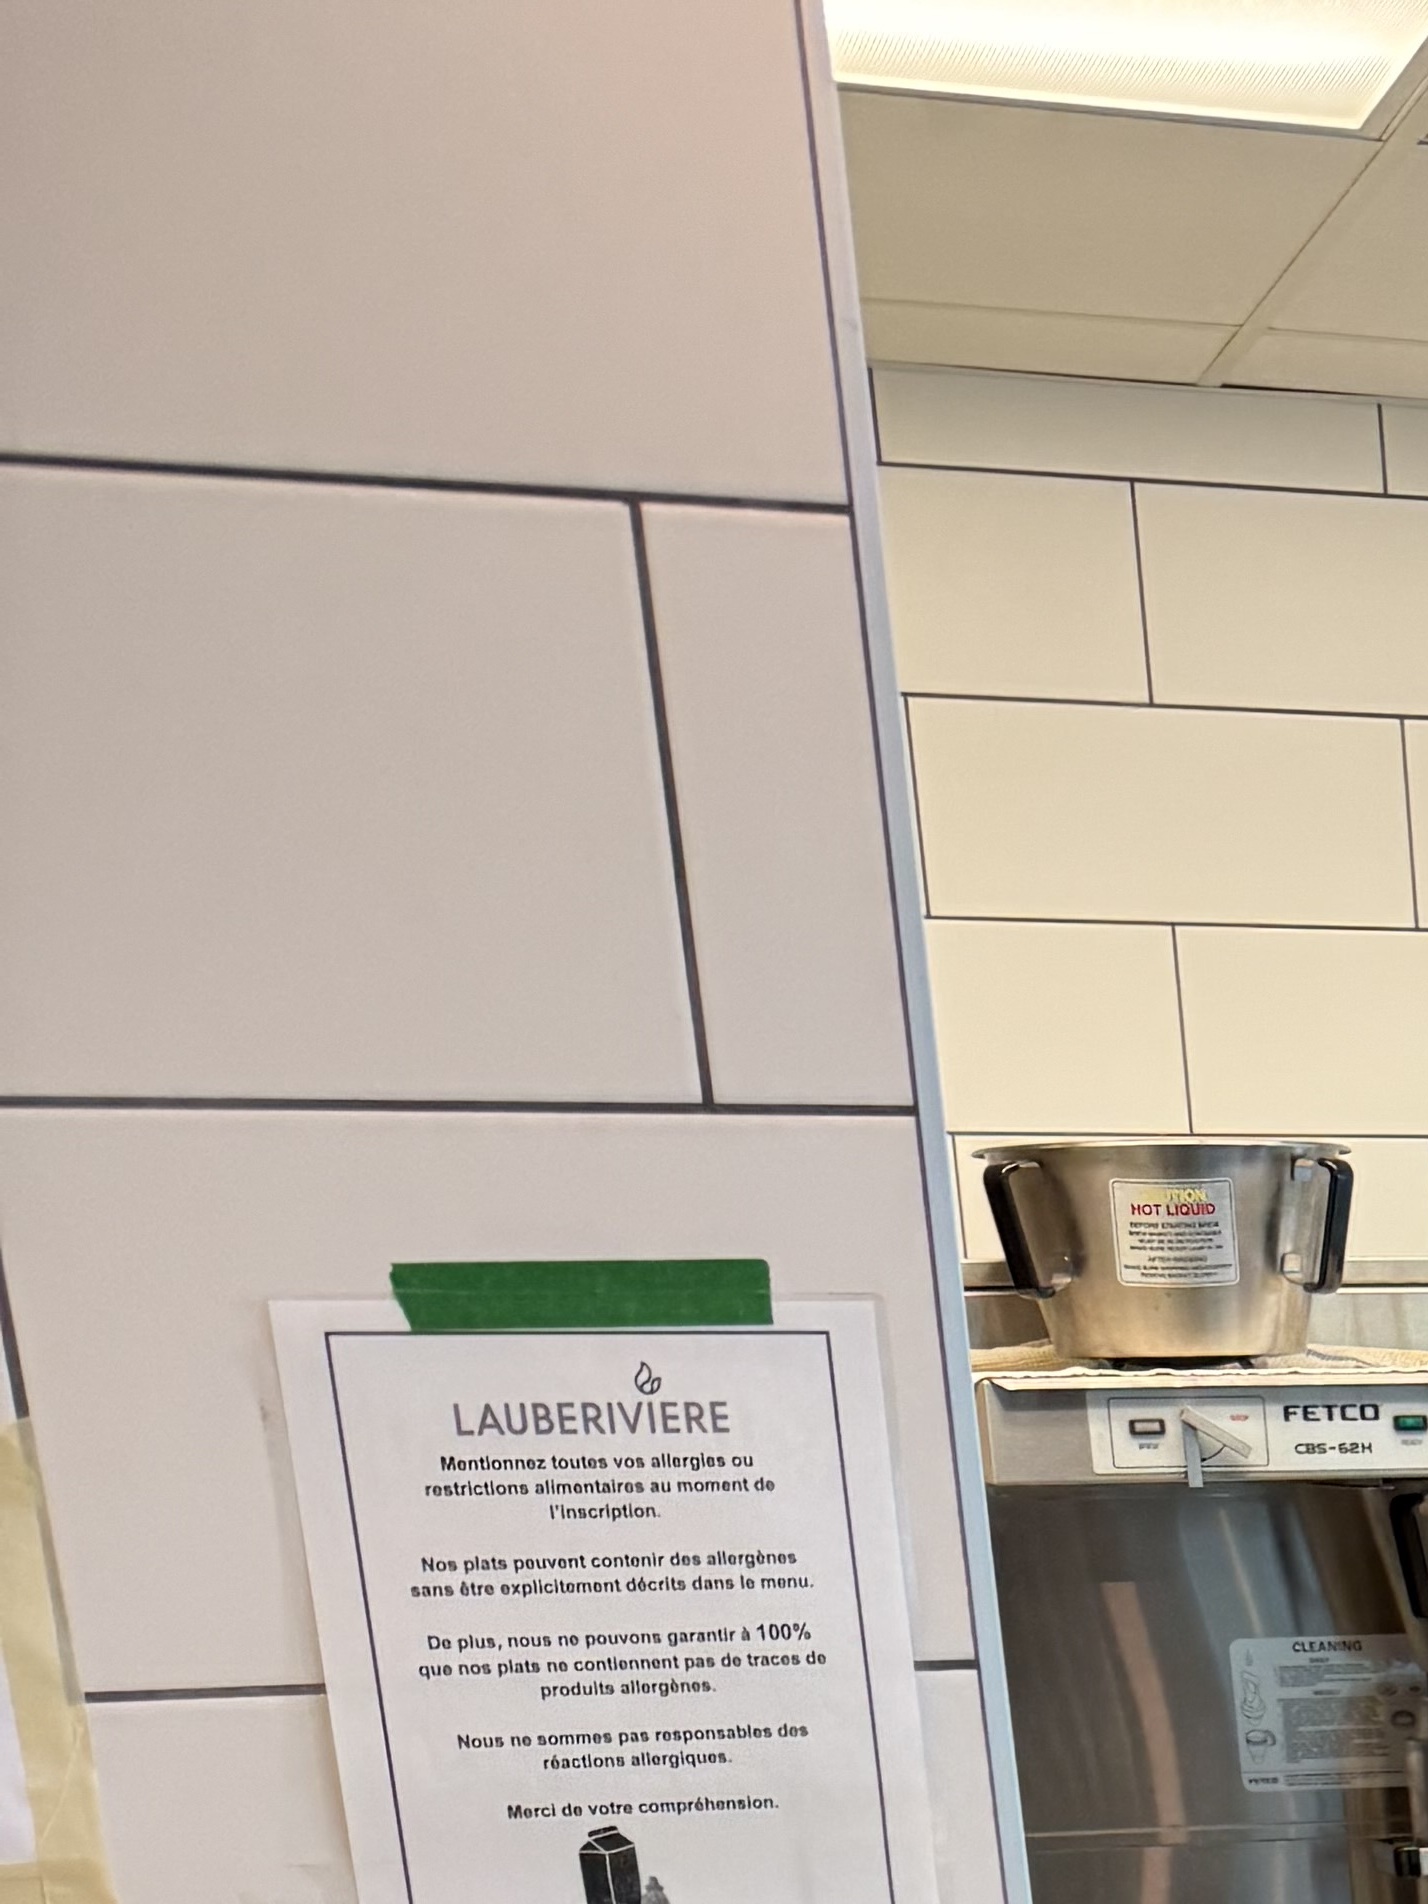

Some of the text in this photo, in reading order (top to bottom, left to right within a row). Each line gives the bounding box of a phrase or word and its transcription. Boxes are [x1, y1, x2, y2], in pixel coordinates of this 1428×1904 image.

[1130, 1202, 1216, 1217] HOT LIQUID
[452, 1400, 731, 1437] LAUBERIVIERE
[1282, 1403, 1380, 1423] FETCO
[439, 1451, 754, 1472] Mentionnez toutes vos allergies ou
[424, 1476, 776, 1497] restrictions alimentaires au moment de
[420, 1549, 798, 1576] Nos plats peuvent contenir des allergènes
[410, 1573, 815, 1599] sans être explicitement décrits dans le menu.
[426, 1621, 812, 1654] De plus, nous ne pouvons garantir à 100%
[1291, 1640, 1363, 1653] CLEANING
[418, 1649, 827, 1681] que nos plats ne contiennent pas de traces de
[540, 1677, 717, 1702] produits allergènes.
[456, 1722, 809, 1750] Nous ne sommes pas responsables des
[543, 1749, 733, 1771] réactions allergiques.
[506, 1794, 780, 1820] Merci de votre compréhension.
